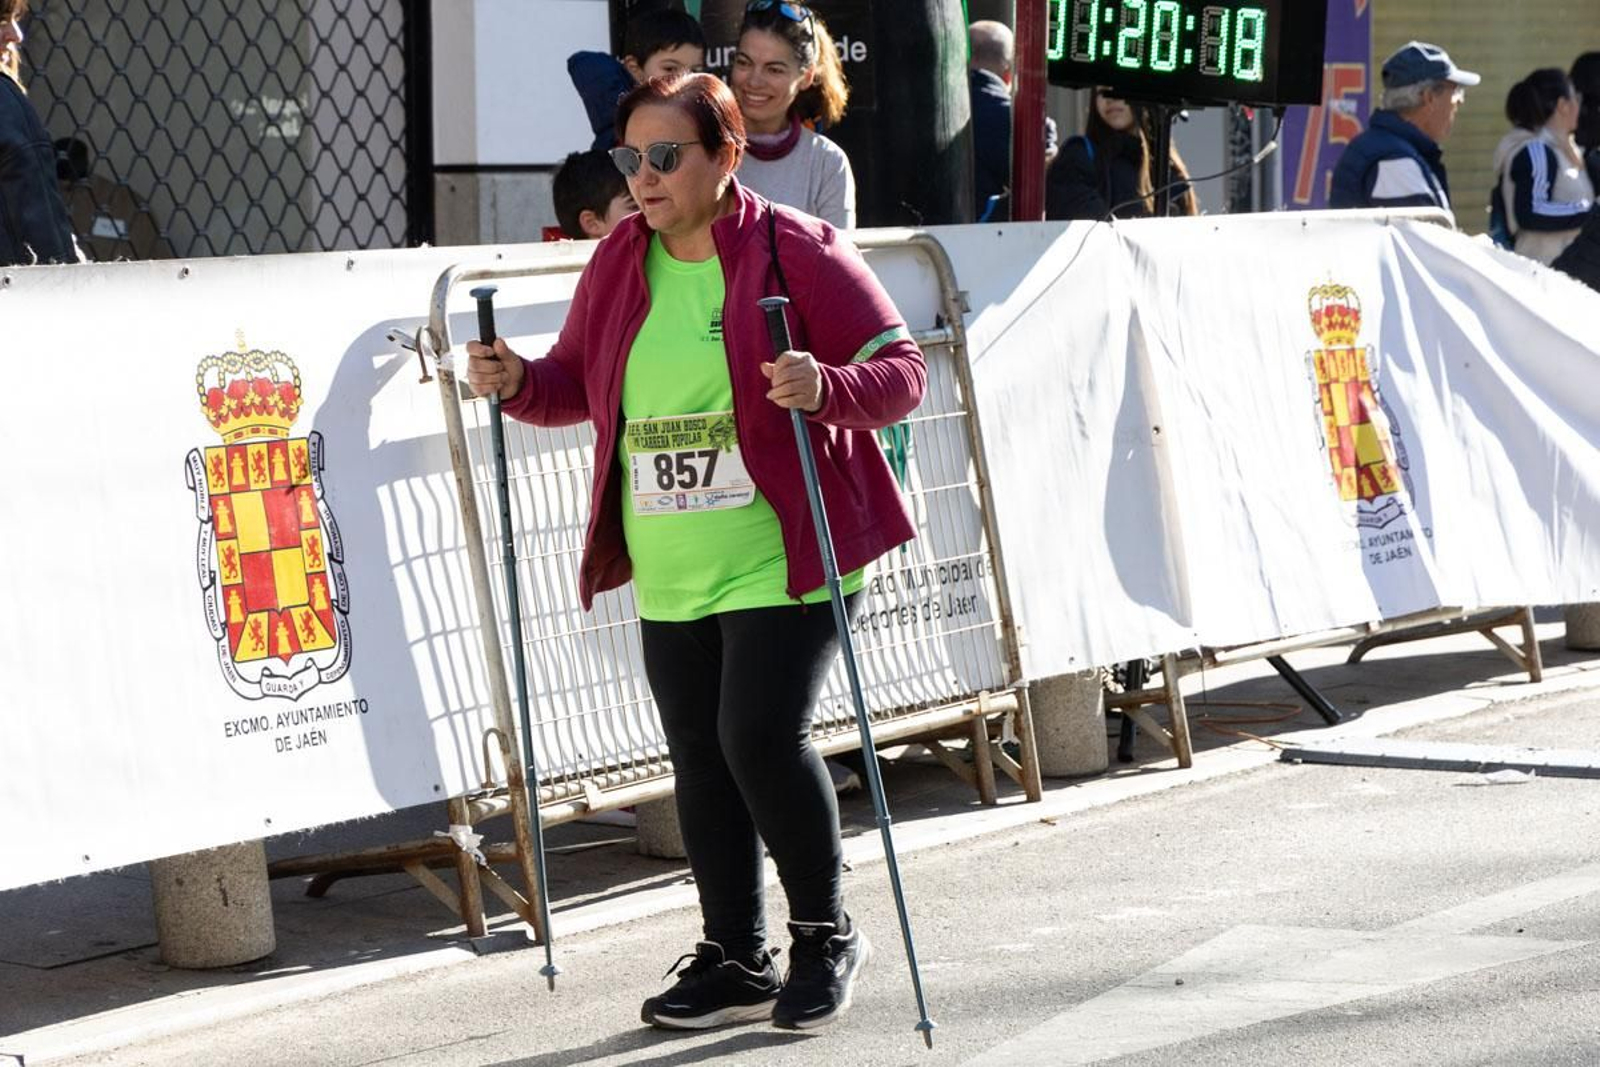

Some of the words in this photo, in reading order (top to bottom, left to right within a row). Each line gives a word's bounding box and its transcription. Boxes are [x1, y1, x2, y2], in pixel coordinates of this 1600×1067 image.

[835, 35, 867, 62] de
[643, 422, 658, 435] SAN
[661, 420, 681, 433] JUAN
[684, 418, 707, 432] BOSCO
[640, 434, 670, 448] CARRERA
[671, 432, 702, 447] POPULAR
[311, 441, 320, 491] CASTILLA
[654, 449, 720, 491] 857
[191, 455, 203, 476] MUY
[197, 478, 206, 512] NOBLE
[200, 556, 208, 581] LEAL
[1369, 552, 1383, 565] DE
[337, 572, 346, 594] LOS
[900, 558, 973, 589] Municipal
[207, 595, 219, 632] CIUDAD
[923, 599, 941, 621] de
[220, 645, 227, 657] DE
[265, 682, 298, 694] GUARDA
[299, 680, 304, 688] Y
[224, 717, 273, 738] EXCMO.
[276, 698, 369, 730] AYUNTAMIENTO
[275, 737, 293, 753] DE
[295, 727, 327, 750] JAÉN
